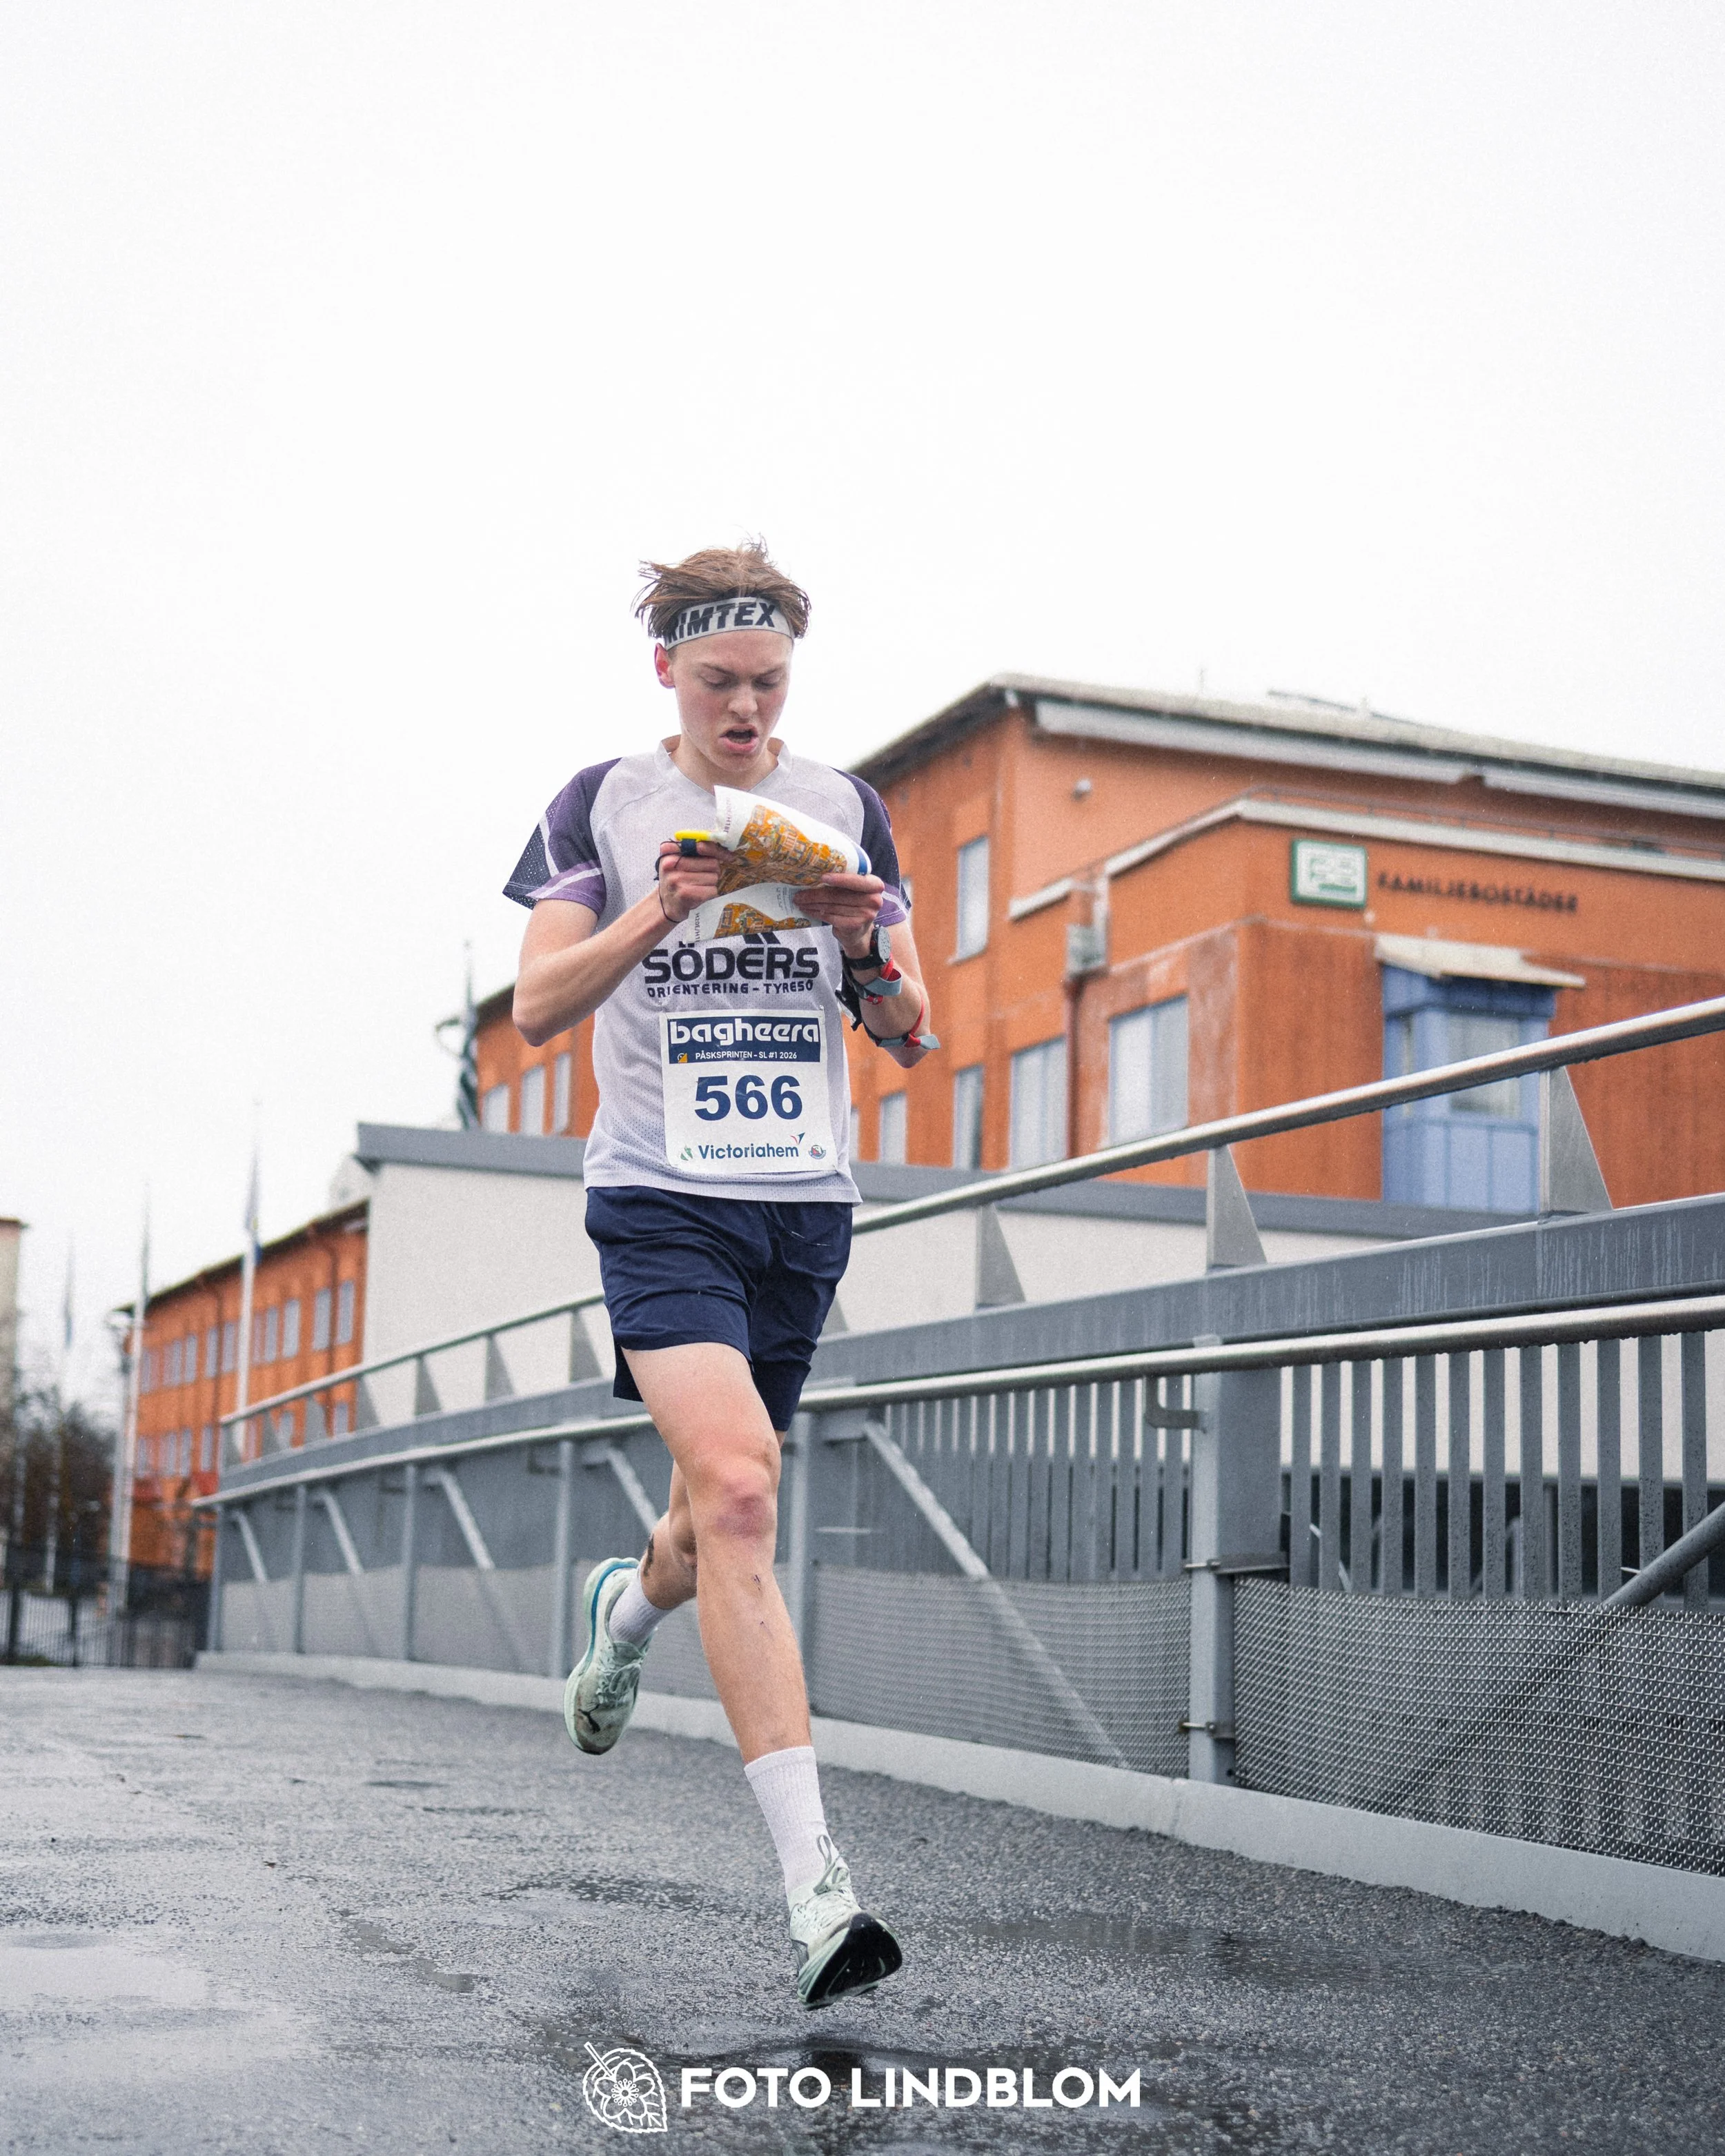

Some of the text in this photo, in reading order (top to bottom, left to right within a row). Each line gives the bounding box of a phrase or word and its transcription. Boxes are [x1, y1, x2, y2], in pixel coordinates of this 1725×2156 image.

[642, 941, 820, 984] SÖDERS
[647, 983, 749, 998] ORIENTERING
[670, 1018, 820, 1046] bagheera
[696, 1050, 753, 1060] PÅSKSPRINTEN
[694, 1075, 802, 1121] 566
[698, 1143, 799, 1160] Victoriahem
